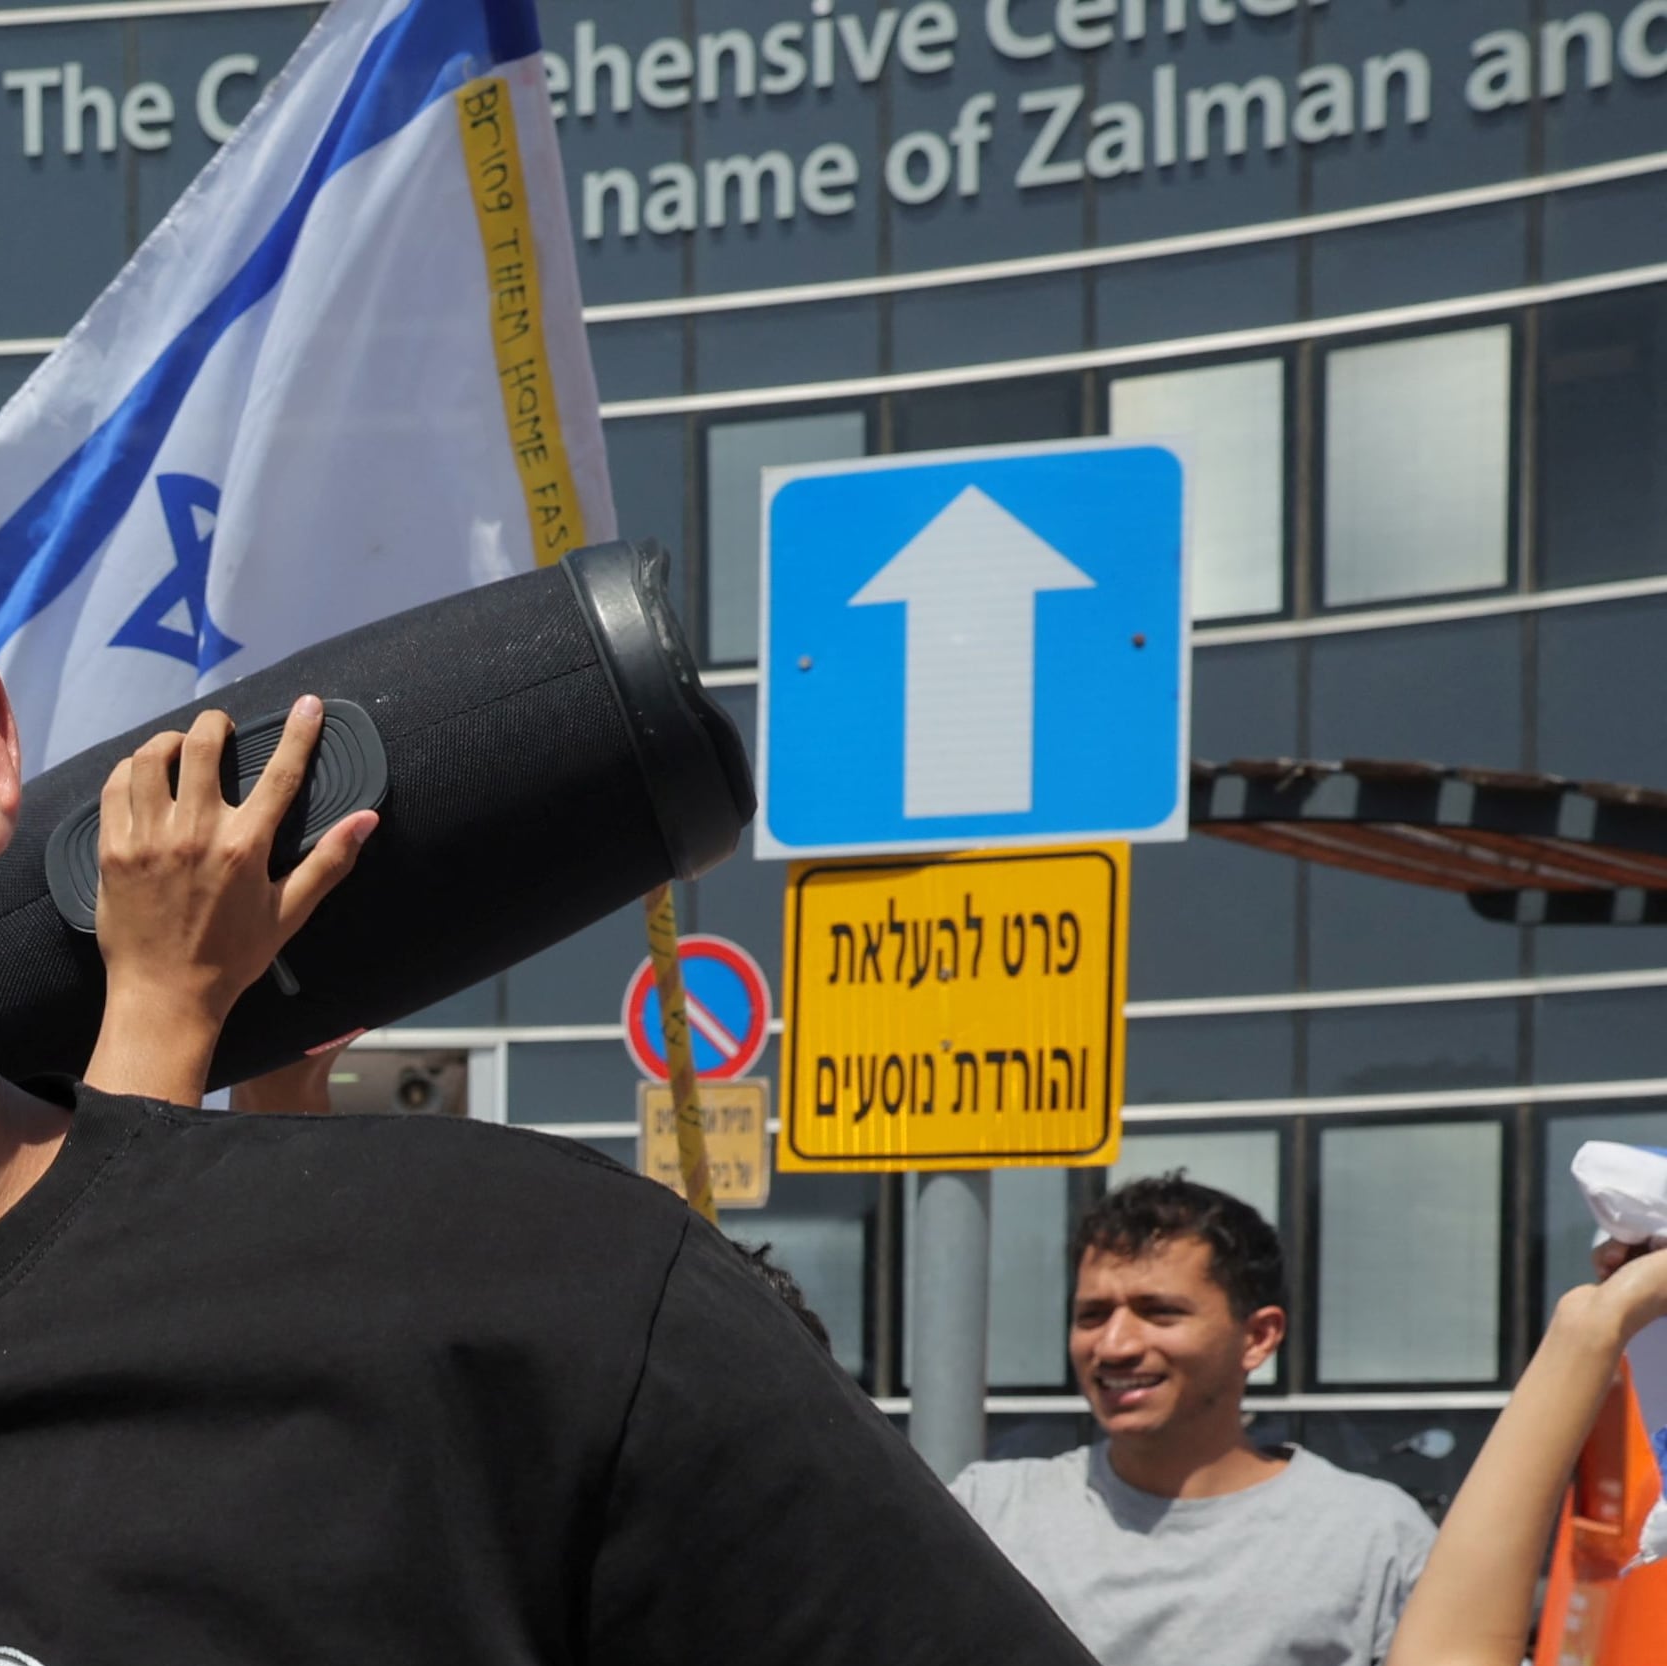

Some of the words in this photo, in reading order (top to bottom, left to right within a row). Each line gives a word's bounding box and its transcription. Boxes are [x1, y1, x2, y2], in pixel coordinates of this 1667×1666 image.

[2, 61, 175, 157] The
[196, 0, 960, 145] Chensive
[582, 142, 859, 240] name
[885, 93, 996, 205] of
[1015, 48, 1430, 188] Zalman
[491, 227, 530, 345] THEM
[533, 481, 570, 551] FAS
[828, 893, 984, 990] להעלאת
[1002, 909, 1082, 978] פרט
[815, 1053, 936, 1124] נוסעים
[951, 1047, 1088, 1115] והורדת
